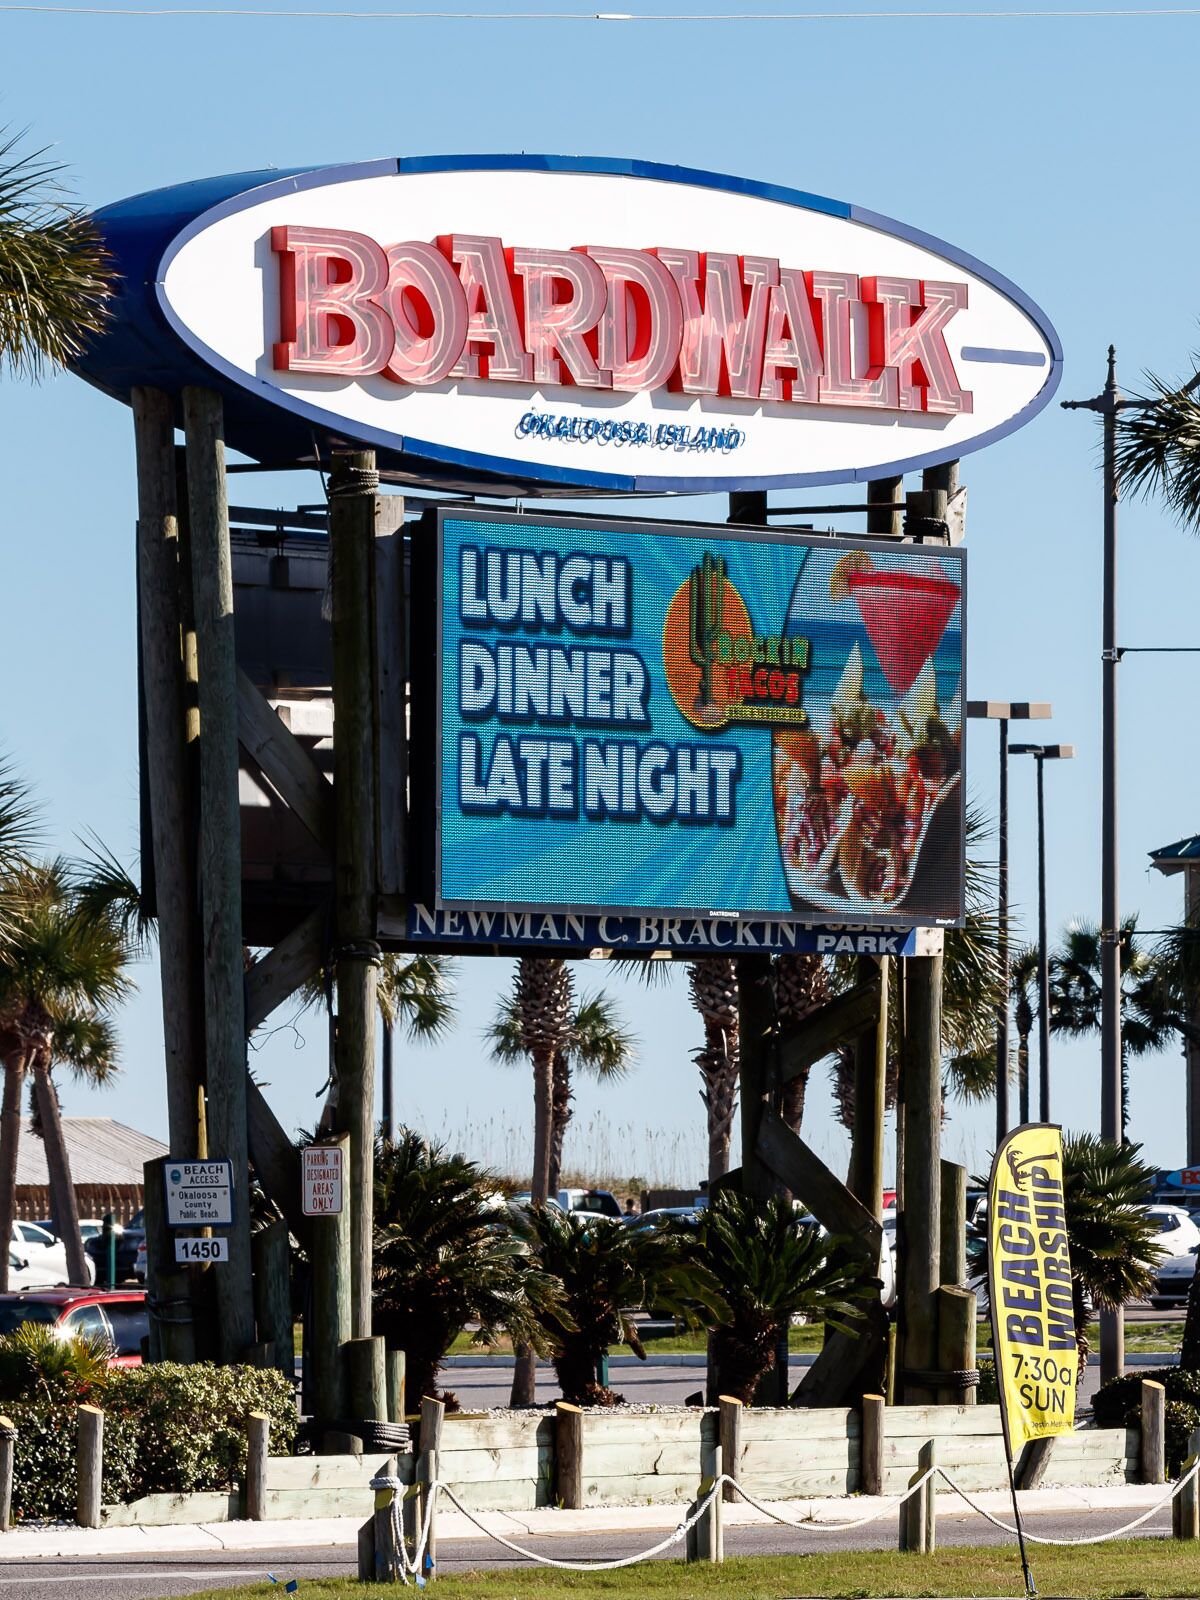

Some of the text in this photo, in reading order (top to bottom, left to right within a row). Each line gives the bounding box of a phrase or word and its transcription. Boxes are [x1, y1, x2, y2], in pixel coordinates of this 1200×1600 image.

[270, 225, 974, 414] BOARDWALK
[655, 423, 741, 450] ISLAND
[459, 545, 630, 633] LUNCH
[459, 640, 650, 727] DINNER
[726, 667, 800, 703] TACOS
[459, 735, 740, 822] LATE NIGHT
[413, 903, 586, 942] NEWMAN
[636, 917, 798, 948] BRACKIN
[816, 934, 899, 953] PARK
[184, 1165, 223, 1175] BEACH
[306, 1153, 329, 1166] PARKING
[189, 1175, 220, 1184] ACCESS
[306, 1168, 339, 1181] DESIGNATED
[178, 1191, 218, 1200] Okaloosa
[312, 1182, 334, 1195] AREAS
[179, 1209, 219, 1219] Public Beach
[184, 1201, 212, 1209] County
[312, 1197, 334, 1210] ONLY
[181, 1241, 221, 1259] 1450
[1031, 1165, 1077, 1351] WORSHIP
[998, 1189, 1045, 1347] BEACH
[1011, 1353, 1072, 1386] 7:30a
[1020, 1383, 1066, 1415] SUN
